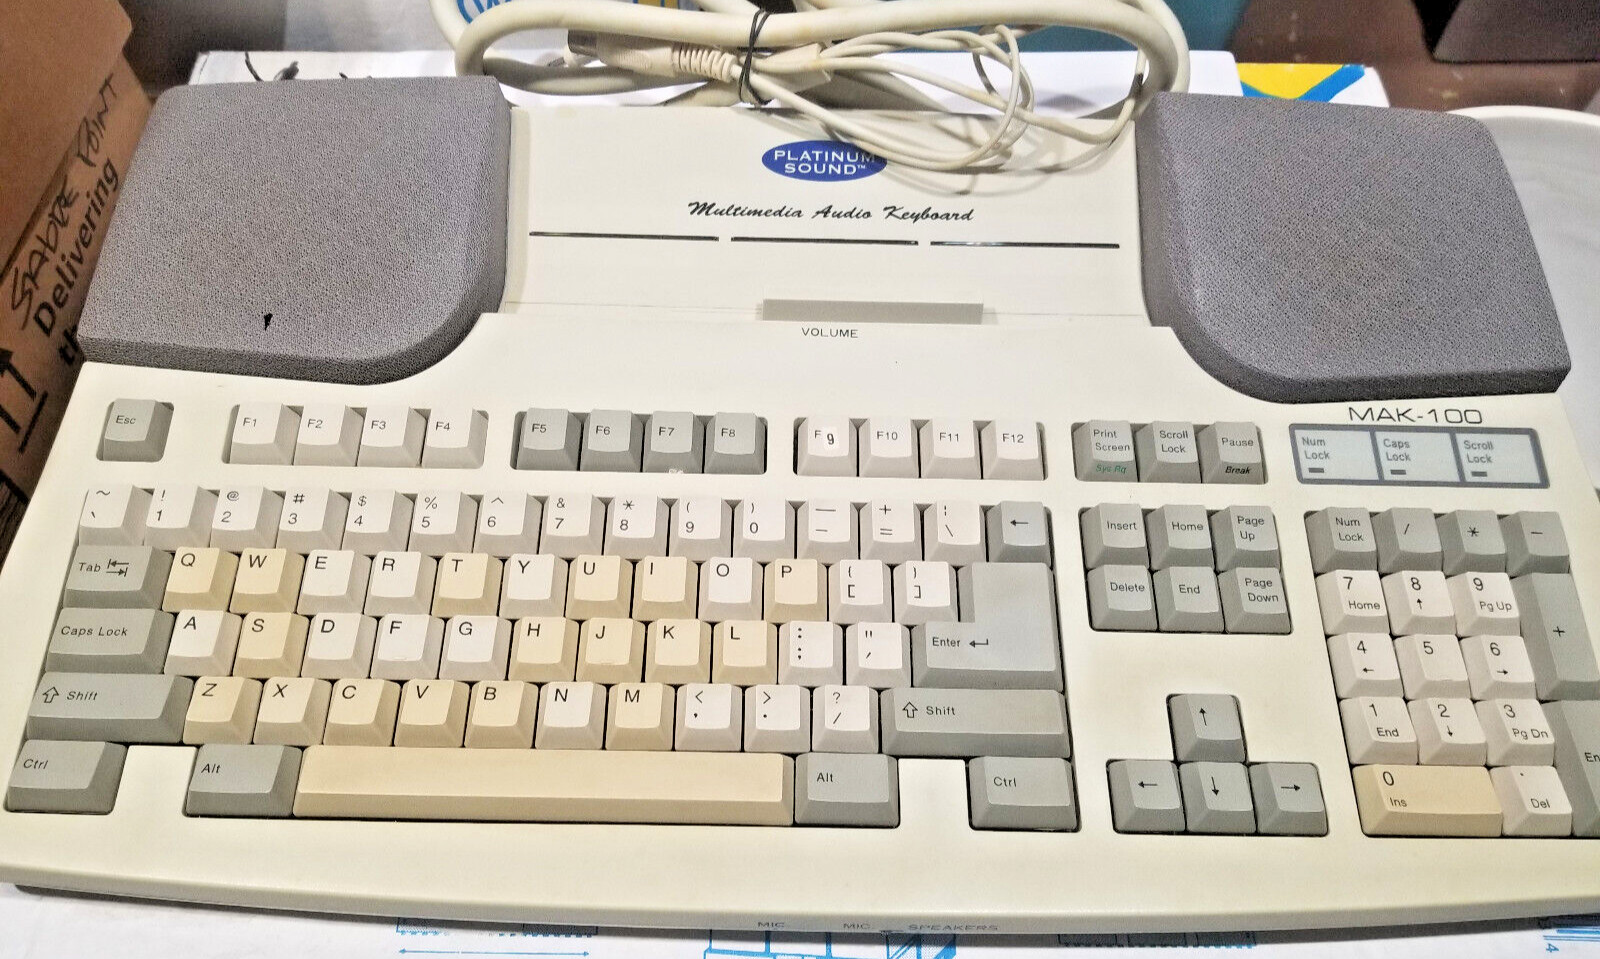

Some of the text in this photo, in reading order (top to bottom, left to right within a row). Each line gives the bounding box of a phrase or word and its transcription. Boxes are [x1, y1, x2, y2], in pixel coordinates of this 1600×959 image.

[774, 150, 876, 163] PLATINUM
[688, 201, 974, 223] Multimedia Audio Keyboard
[34, 158, 118, 338] Delivering
[802, 328, 857, 338] VOLUME
[116, 415, 136, 424] Esc
[1348, 407, 1482, 425] MAK-100
[243, 417, 256, 427] F1
[308, 419, 323, 428] F2
[371, 420, 386, 430] F3
[436, 422, 450, 430] F4
[532, 424, 546, 433] F5
[596, 425, 610, 435] F6
[659, 427, 674, 436] F7
[721, 428, 735, 437] F8
[1094, 429, 1117, 439] Print
[877, 431, 897, 440] F10
[940, 433, 958, 441] F11
[1003, 433, 1023, 443] F12
[1160, 430, 1188, 439] Scroll
[1095, 442, 1131, 452] Screen
[1222, 438, 1253, 446] Pause
[1302, 437, 1325, 446] Num
[1383, 438, 1411, 450] Caps
[1463, 440, 1494, 450] Scroll
[1162, 444, 1185, 453] Lock
[1304, 451, 1329, 459] Lock
[1386, 452, 1411, 461] Lock
[1467, 453, 1492, 463] Lock
[1226, 466, 1250, 474] Break
[157, 510, 162, 521] 1
[221, 511, 231, 523] 2
[288, 513, 297, 524] 3
[354, 516, 362, 526] 4
[422, 516, 430, 528] 5
[488, 517, 496, 527] 6
[555, 518, 564, 529] 7
[620, 520, 628, 530] 8
[1107, 521, 1136, 530] Insert
[1172, 522, 1203, 530] Home
[1237, 516, 1264, 527] Page
[1336, 517, 1360, 526] Num
[686, 522, 694, 533] 9
[750, 522, 758, 533] 0
[1240, 531, 1255, 542] Up
[1339, 532, 1363, 541] Lock
[181, 553, 195, 567] Q
[250, 555, 267, 568] W
[315, 556, 327, 569] E
[382, 558, 395, 571] R
[452, 559, 463, 572] T
[79, 563, 100, 572] Tab
[518, 561, 530, 573] Y
[584, 562, 595, 575] U
[650, 563, 653, 575] I
[717, 564, 729, 577] O
[782, 566, 792, 578] P
[1110, 582, 1145, 592] Delete
[1245, 578, 1272, 589] Page
[1343, 577, 1353, 589] 7
[1411, 577, 1421, 590] 8
[1473, 578, 1483, 591] 9
[1179, 584, 1200, 594] End
[1248, 593, 1278, 602] Down
[1349, 601, 1380, 609] Home
[1479, 600, 1512, 612] Pg Up
[184, 617, 196, 630] A
[252, 619, 264, 632] S
[321, 620, 334, 633] D
[390, 621, 402, 634] F
[459, 622, 472, 635] G
[61, 626, 127, 637] Caps Lock
[528, 623, 540, 637] H
[596, 626, 605, 639] J
[664, 626, 674, 638] K
[731, 627, 740, 640] L
[933, 637, 960, 647] Enter
[1357, 641, 1366, 653] 4
[1423, 641, 1433, 654] 5
[1490, 642, 1500, 656] 6
[202, 683, 217, 696] Z
[273, 684, 288, 697] X
[342, 686, 356, 699] C
[417, 686, 429, 698] V
[484, 687, 496, 700] B
[67, 691, 97, 700] Shift
[555, 689, 568, 702] N
[625, 690, 640, 702] M
[833, 692, 840, 703] ?
[927, 706, 955, 715] Shift
[1369, 704, 1377, 716] 1
[1438, 704, 1450, 717] 2
[1504, 705, 1515, 718] 3
[1377, 727, 1399, 737] End
[1512, 728, 1549, 740] Pg Dn
[24, 759, 48, 769] Ctrl
[201, 764, 220, 773] Alt
[817, 773, 833, 782] Alt
[994, 777, 1016, 787] Ctrl
[1383, 772, 1394, 786] 0
[1390, 797, 1407, 807] Ins
[1531, 798, 1550, 808] Del
[843, 922, 872, 930] MIC
[908, 922, 998, 932] SPEAKERS
